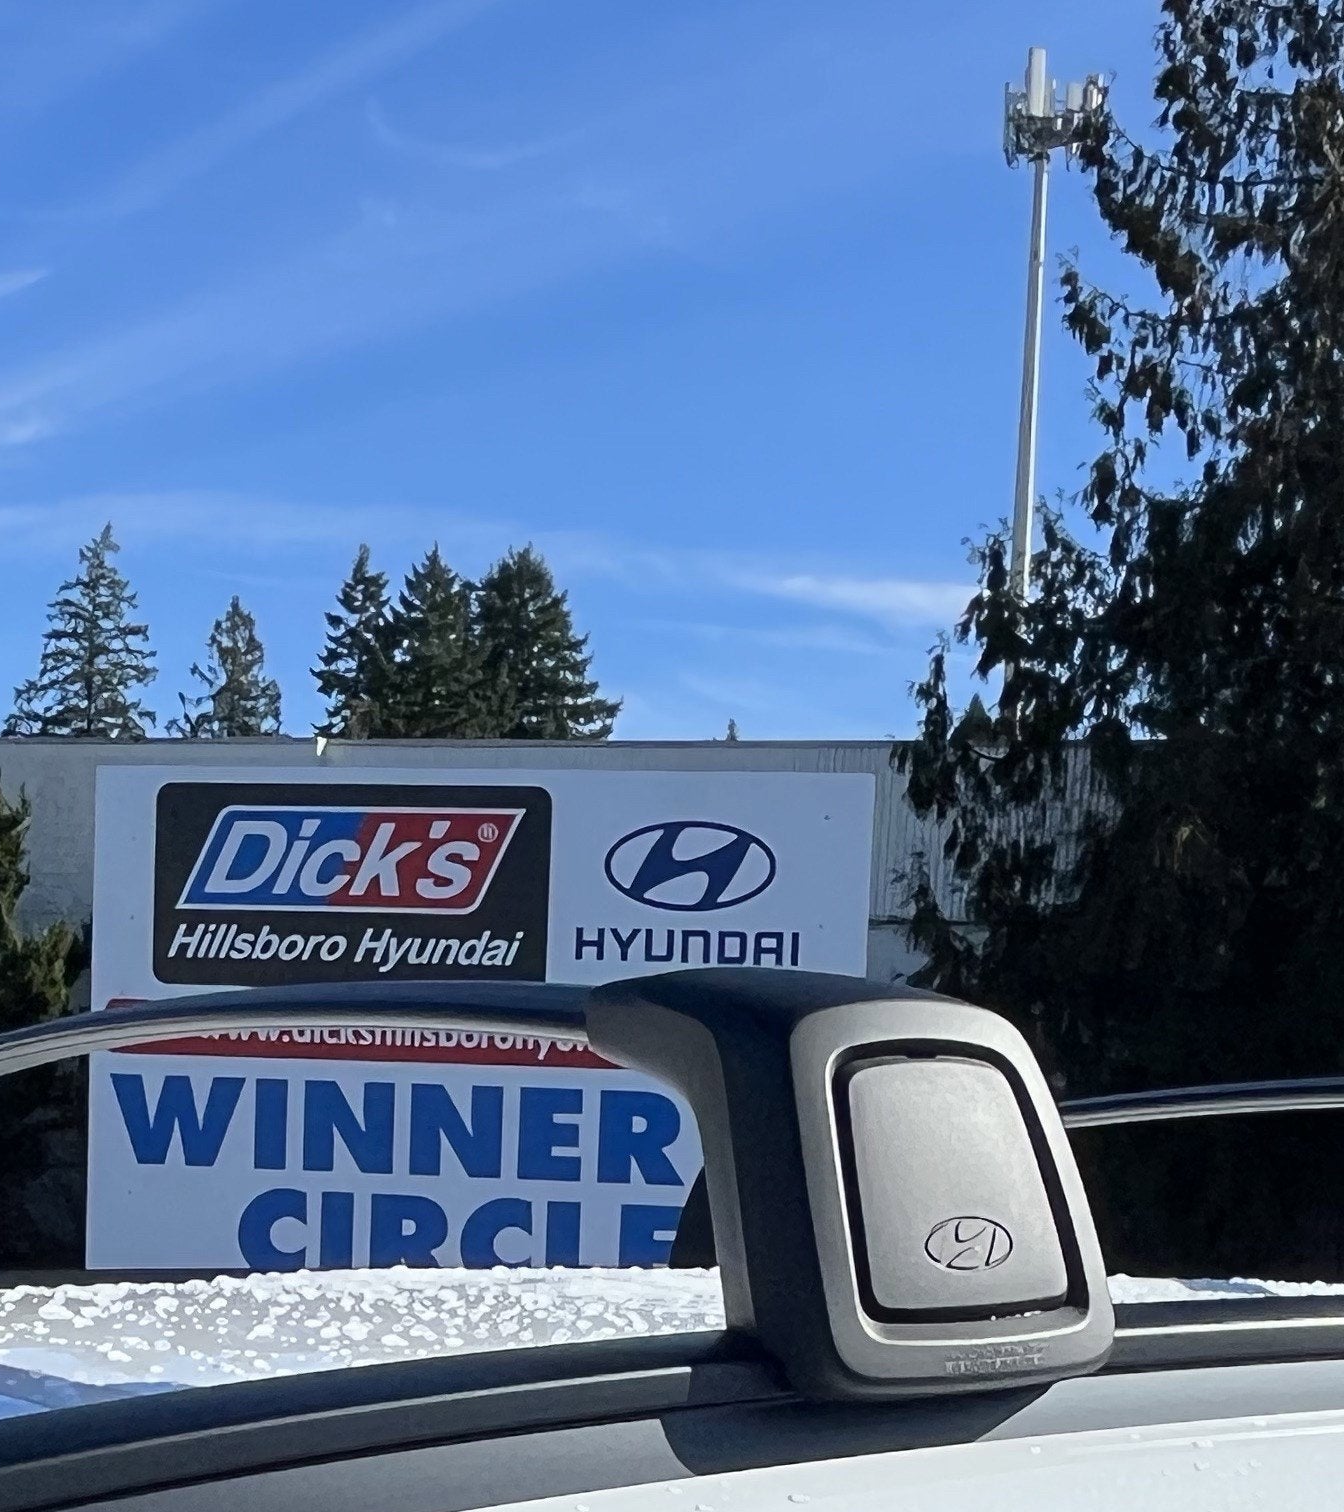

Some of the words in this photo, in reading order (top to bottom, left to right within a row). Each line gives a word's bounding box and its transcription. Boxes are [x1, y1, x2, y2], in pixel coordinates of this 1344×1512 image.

[203, 817, 484, 900] Dick's
[167, 923, 348, 962] Hillsboro
[355, 927, 525, 973] Hyundai
[574, 926, 801, 967] HYUNDAI
[110, 1073, 685, 1187] WINNER
